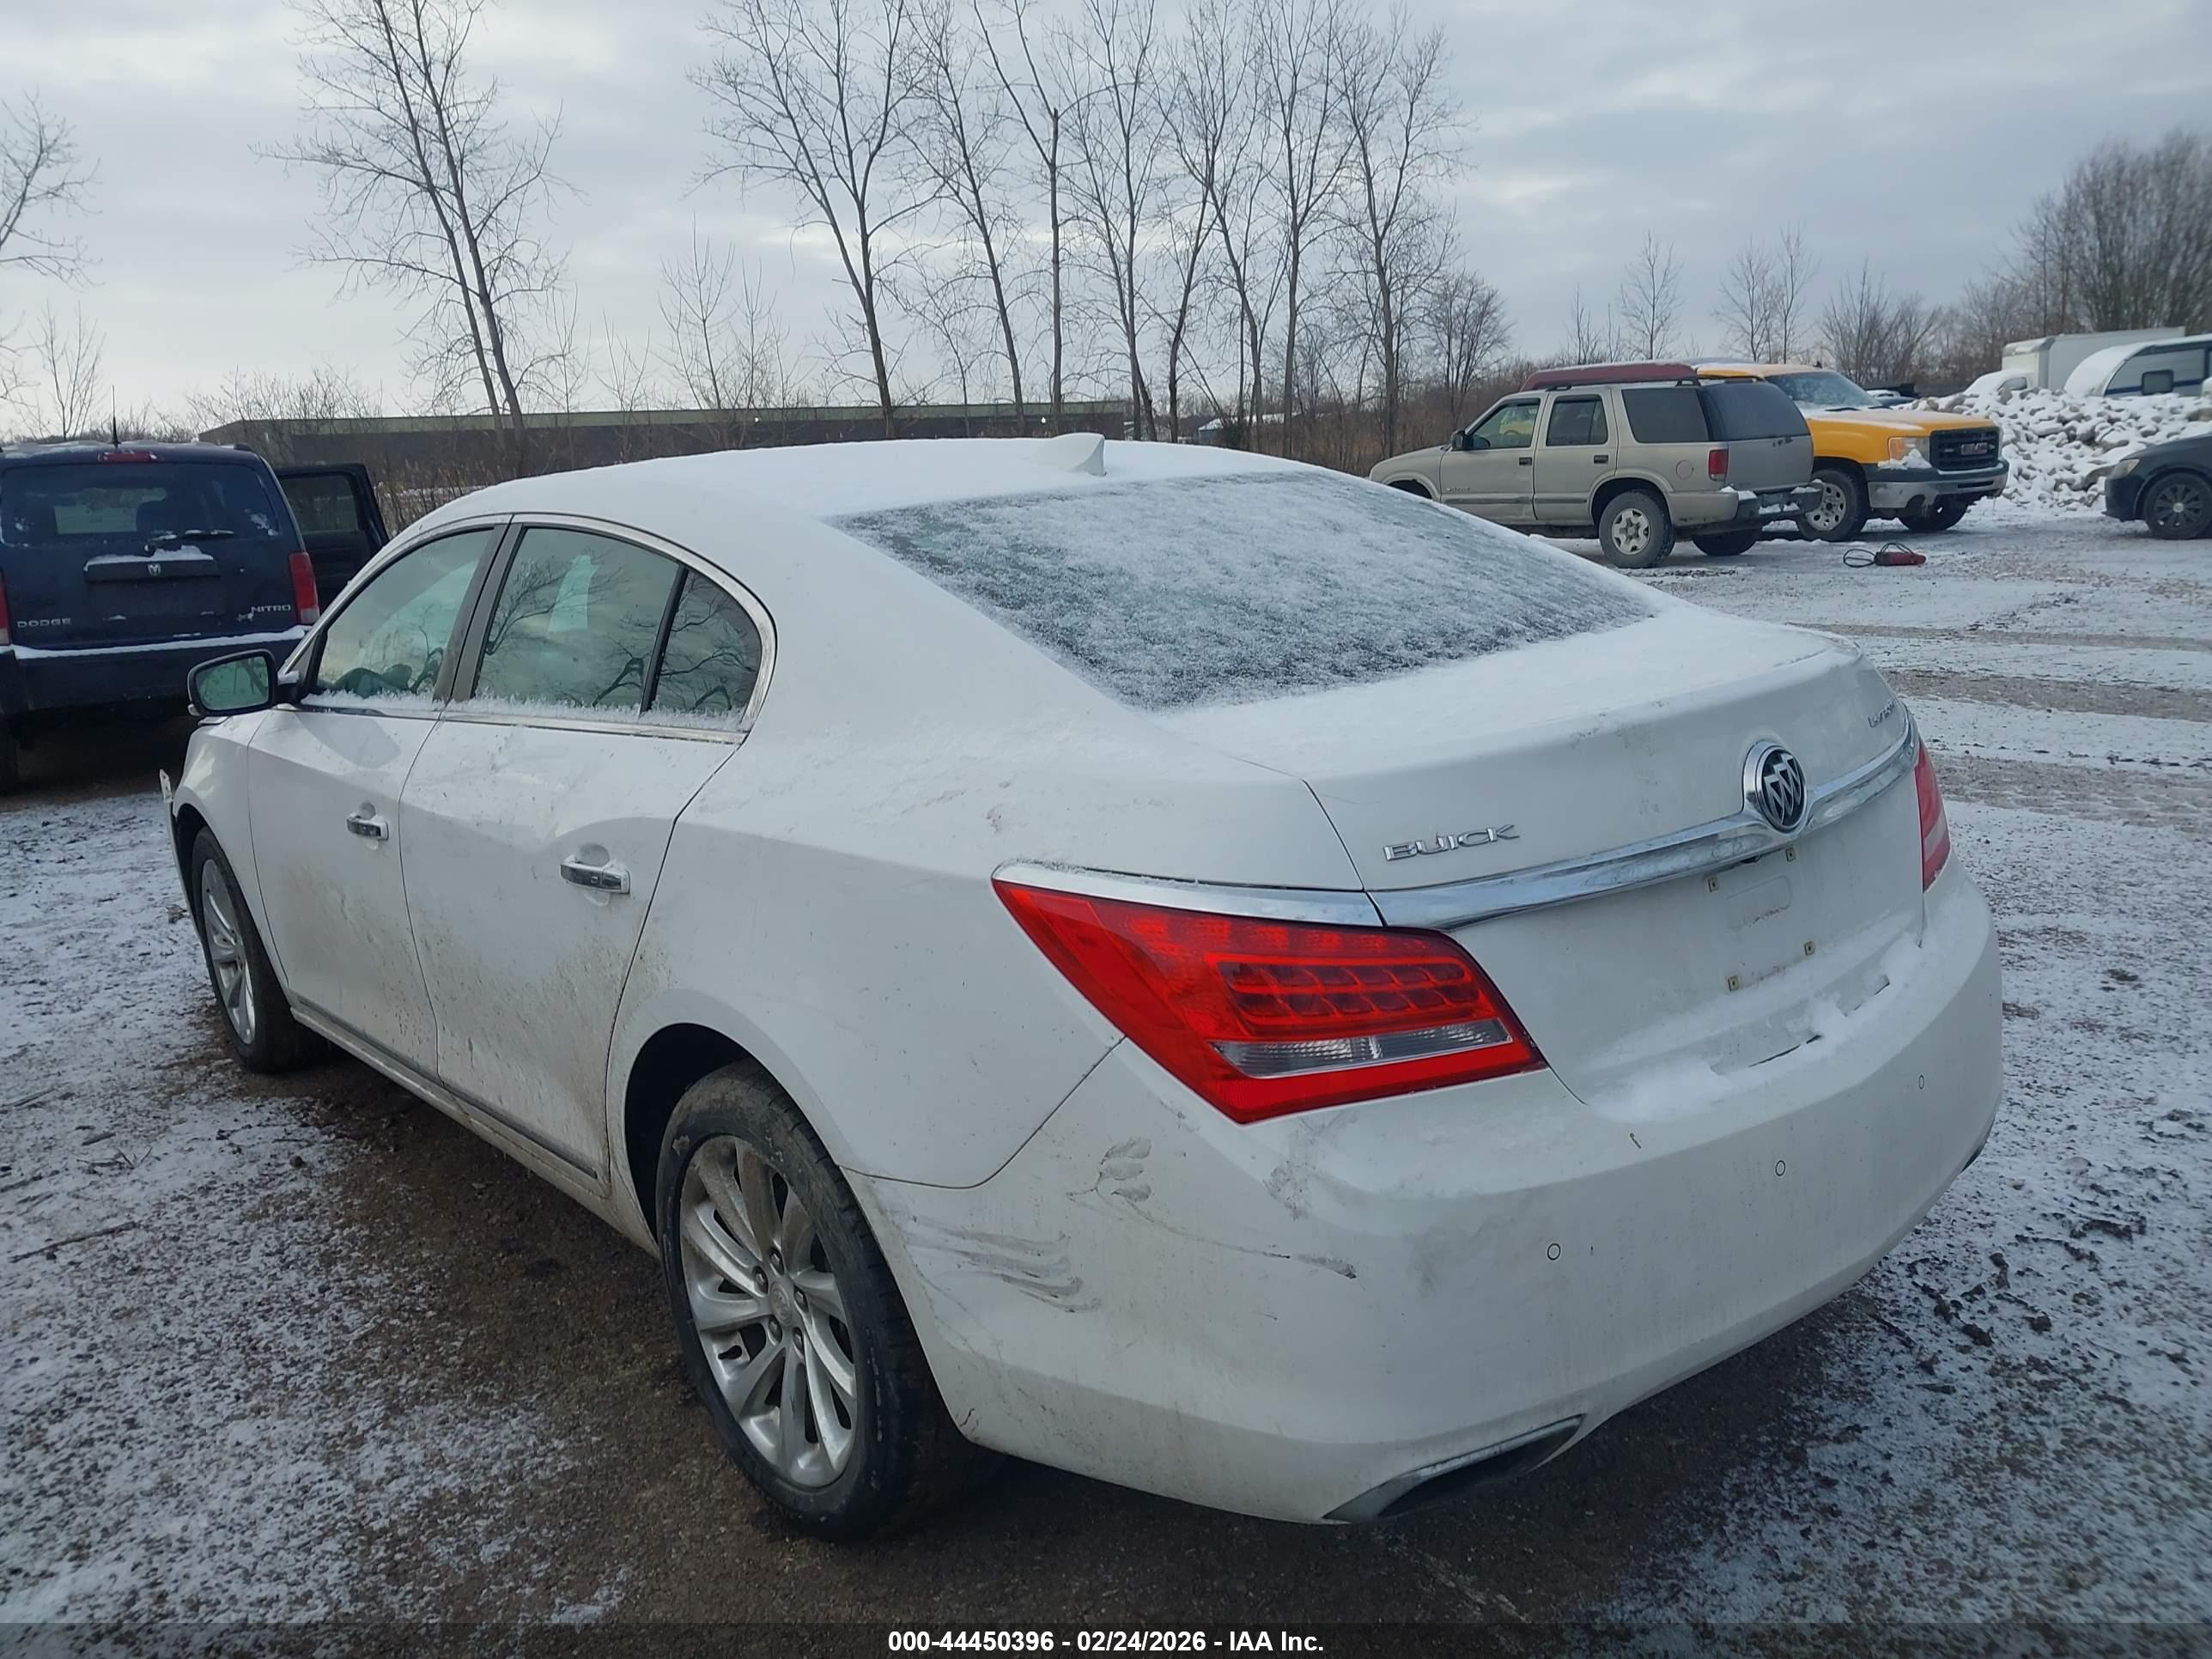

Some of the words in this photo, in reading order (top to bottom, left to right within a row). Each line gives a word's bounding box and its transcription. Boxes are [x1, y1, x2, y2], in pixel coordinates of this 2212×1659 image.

[251, 604, 291, 612] NITRO
[17, 617, 71, 629] DODGE
[1383, 823, 1521, 861] BUICK
